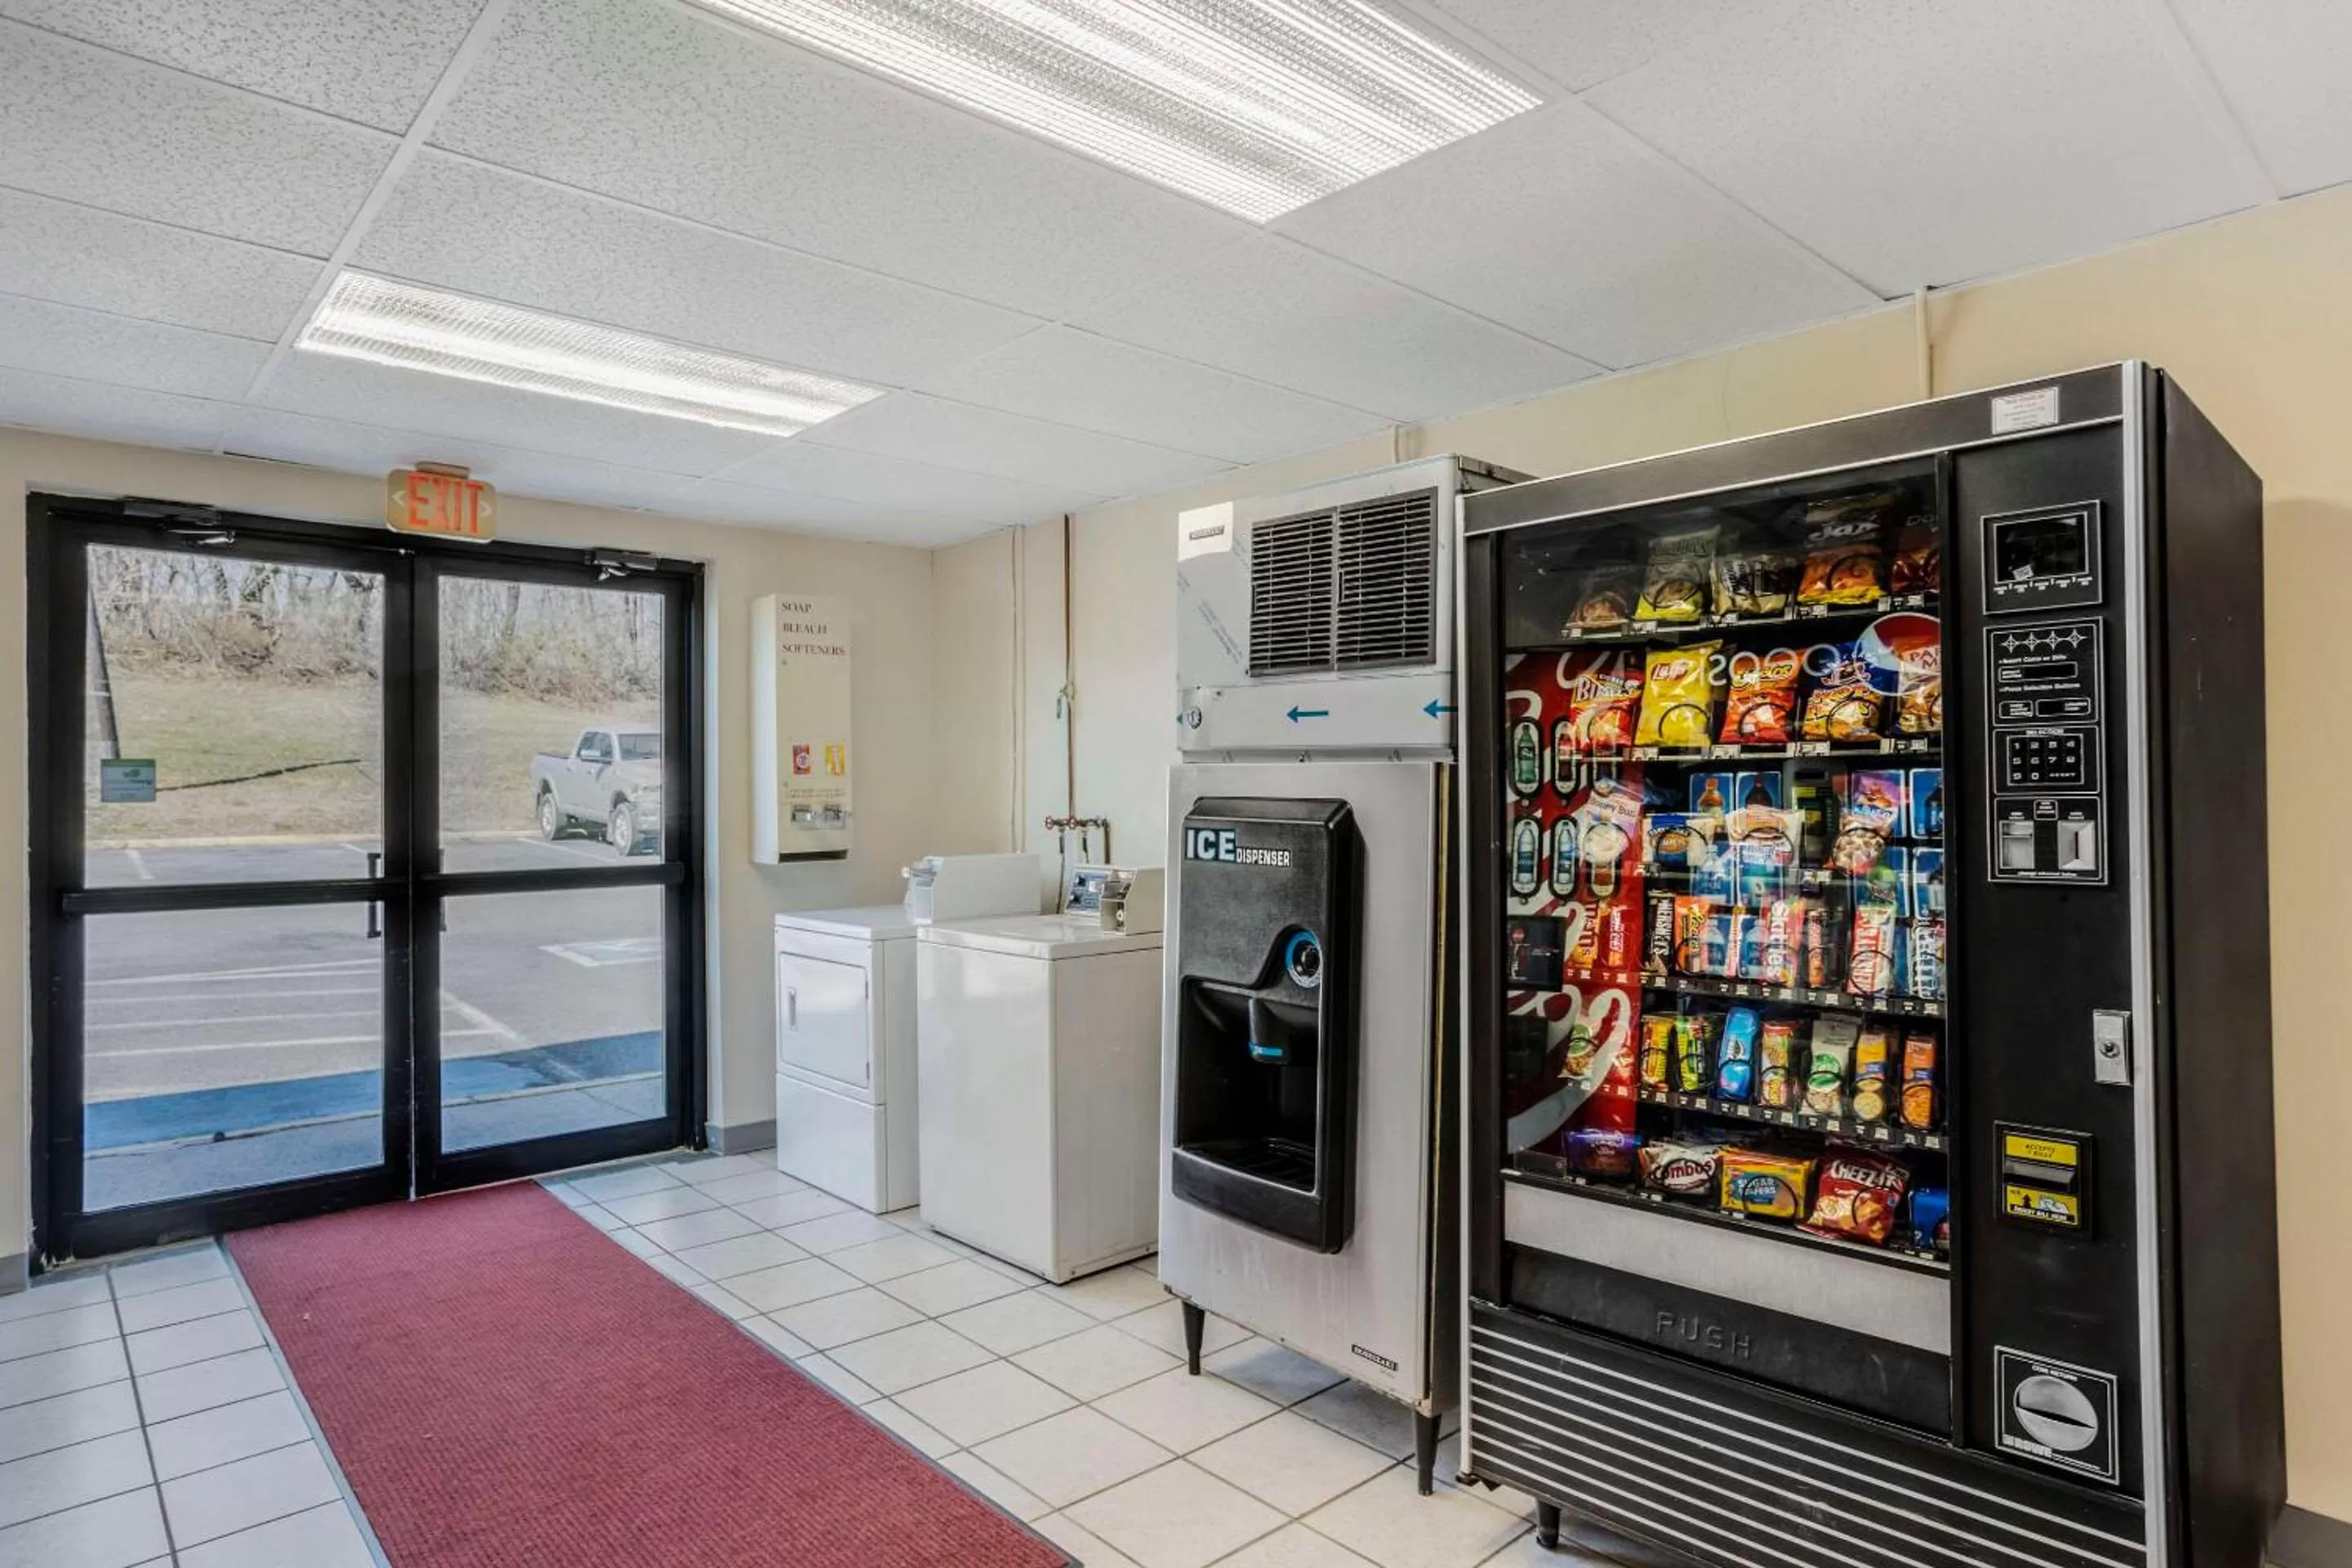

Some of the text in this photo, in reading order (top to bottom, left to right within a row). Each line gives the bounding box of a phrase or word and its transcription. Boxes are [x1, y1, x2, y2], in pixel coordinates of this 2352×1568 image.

[408, 475, 483, 535] EXIT
[782, 602, 812, 613] SOAP
[783, 621, 827, 635] BLEACH
[782, 643, 846, 656] SOFTENERS
[2013, 742, 2020, 751] 1
[2030, 741, 2040, 750] 2
[2030, 756, 2040, 764] 6
[2012, 772, 2022, 780] 9
[1186, 830, 1290, 866] ICE DISPENSER
[1655, 1311, 1751, 1360] PUSH
